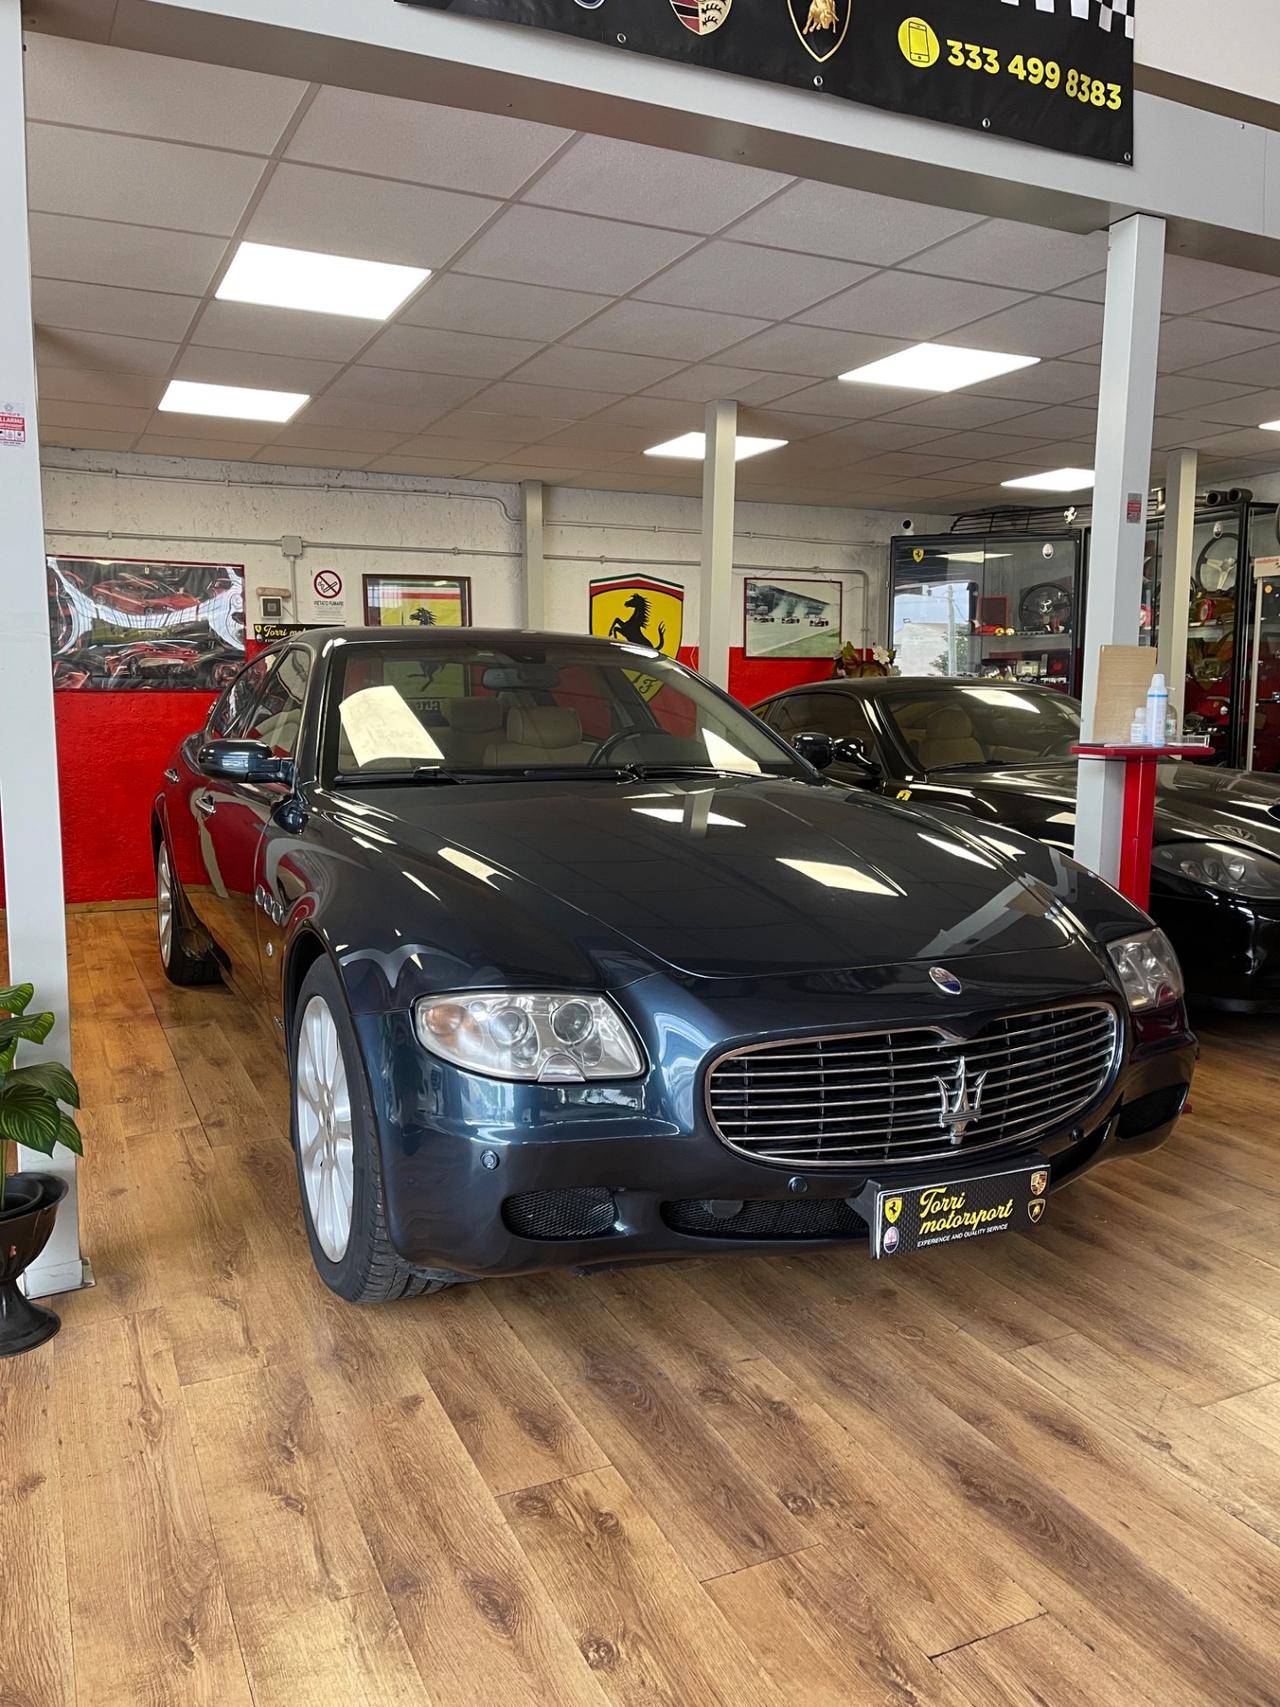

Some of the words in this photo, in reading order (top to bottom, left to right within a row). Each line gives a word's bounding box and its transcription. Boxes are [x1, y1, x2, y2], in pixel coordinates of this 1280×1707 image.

[947, 39, 1000, 74] 333
[1007, 54, 1061, 89] 499
[1065, 68, 1122, 110] 8383
[0, 416, 23, 424] LLARME
[263, 624, 287, 637] Torri
[920, 1187, 966, 1218] Torri
[919, 1199, 1014, 1235] motorsport
[917, 1235, 951, 1248] EXPERIENCE
[951, 1232, 963, 1240] AND
[963, 1228, 986, 1239] QUALITY
[986, 1223, 1009, 1233] SERVICE
